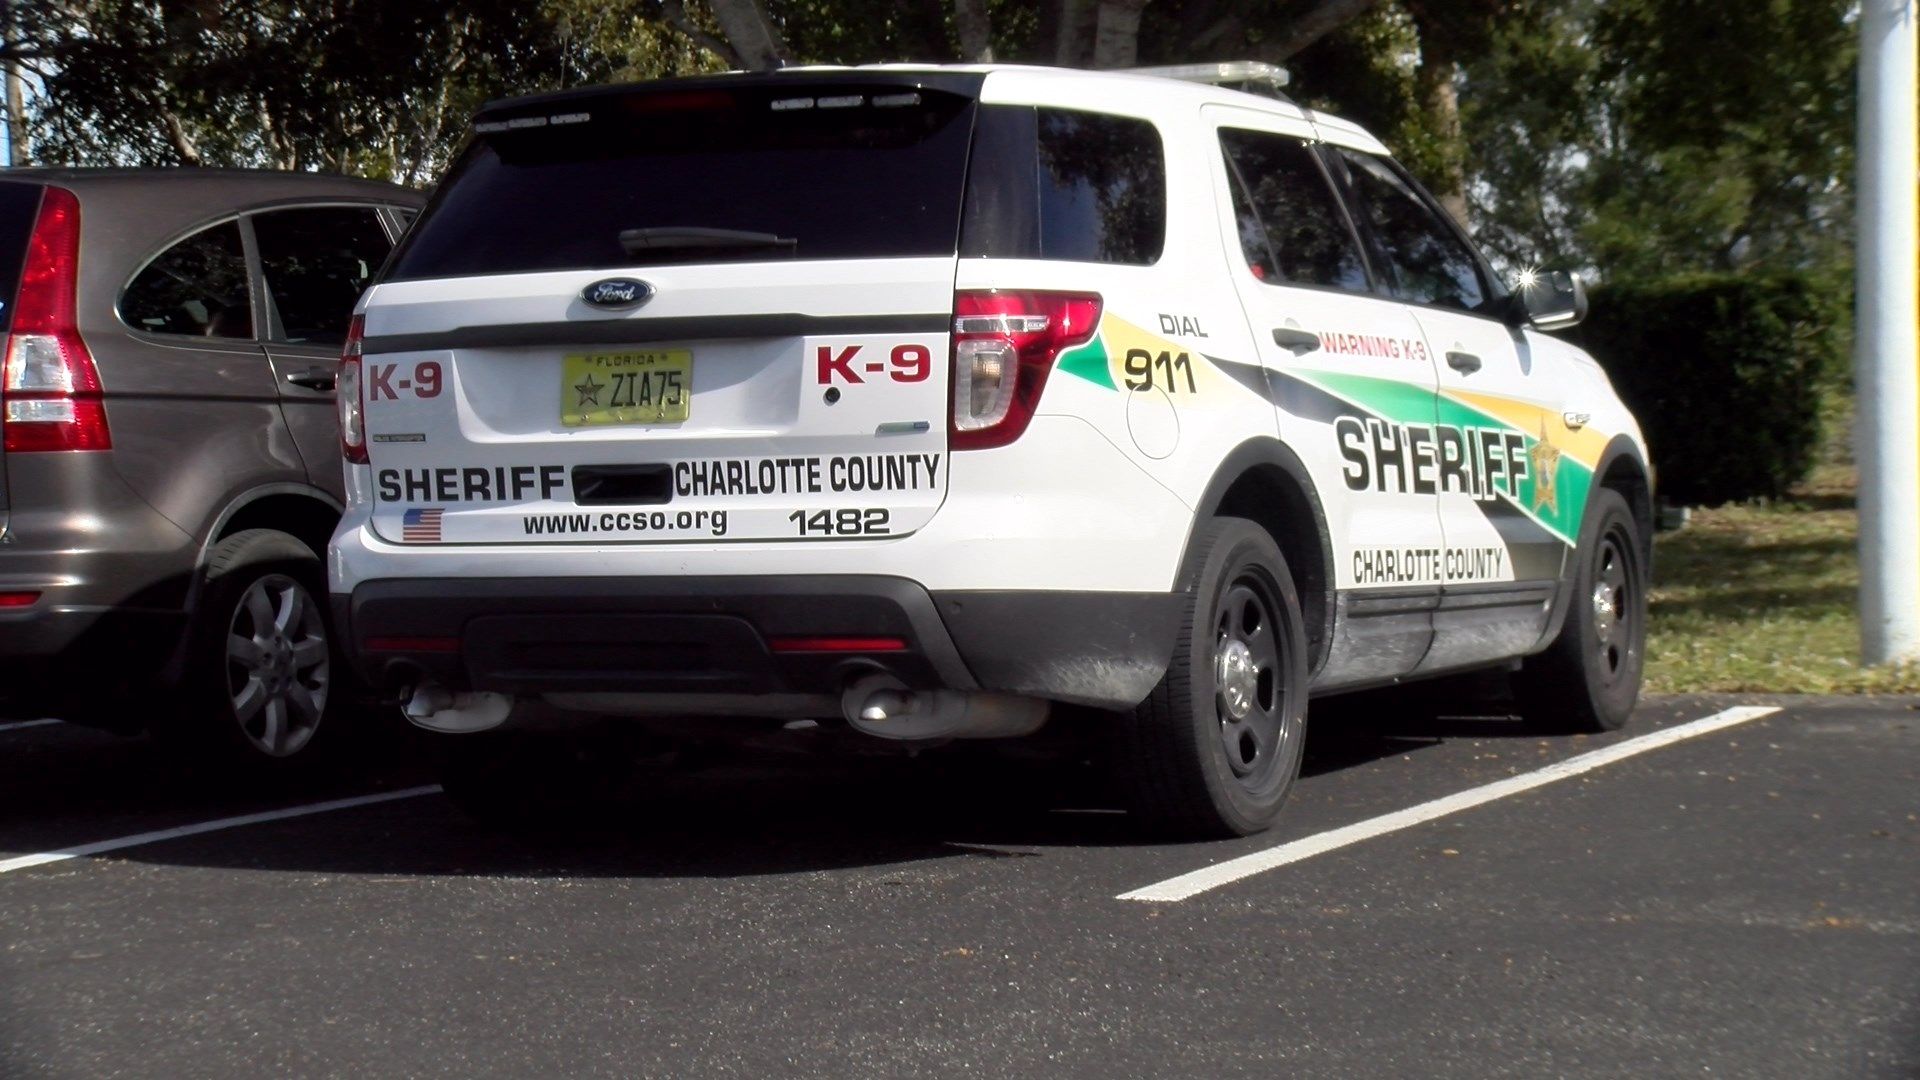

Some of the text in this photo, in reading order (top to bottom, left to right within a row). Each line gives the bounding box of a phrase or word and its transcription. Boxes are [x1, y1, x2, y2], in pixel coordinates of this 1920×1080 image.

[594, 281, 635, 302] Ford
[1158, 313, 1209, 338] DIAL
[596, 354, 655, 367] FLORIDA
[1319, 331, 1427, 361] WARNING K-9
[369, 361, 443, 401] K-9
[817, 344, 932, 385] K-9
[1124, 348, 1197, 393] 911
[610, 371, 682, 407] ZIA75
[675, 453, 940, 497] CHARLOTTE COUNTY
[1335, 418, 1527, 498] SHERIFF
[378, 465, 565, 502] SHERIFF
[523, 510, 728, 536] www.ccso.org
[788, 507, 890, 535] 1482
[1353, 548, 1503, 583] CHARLOTTE COUNTY
